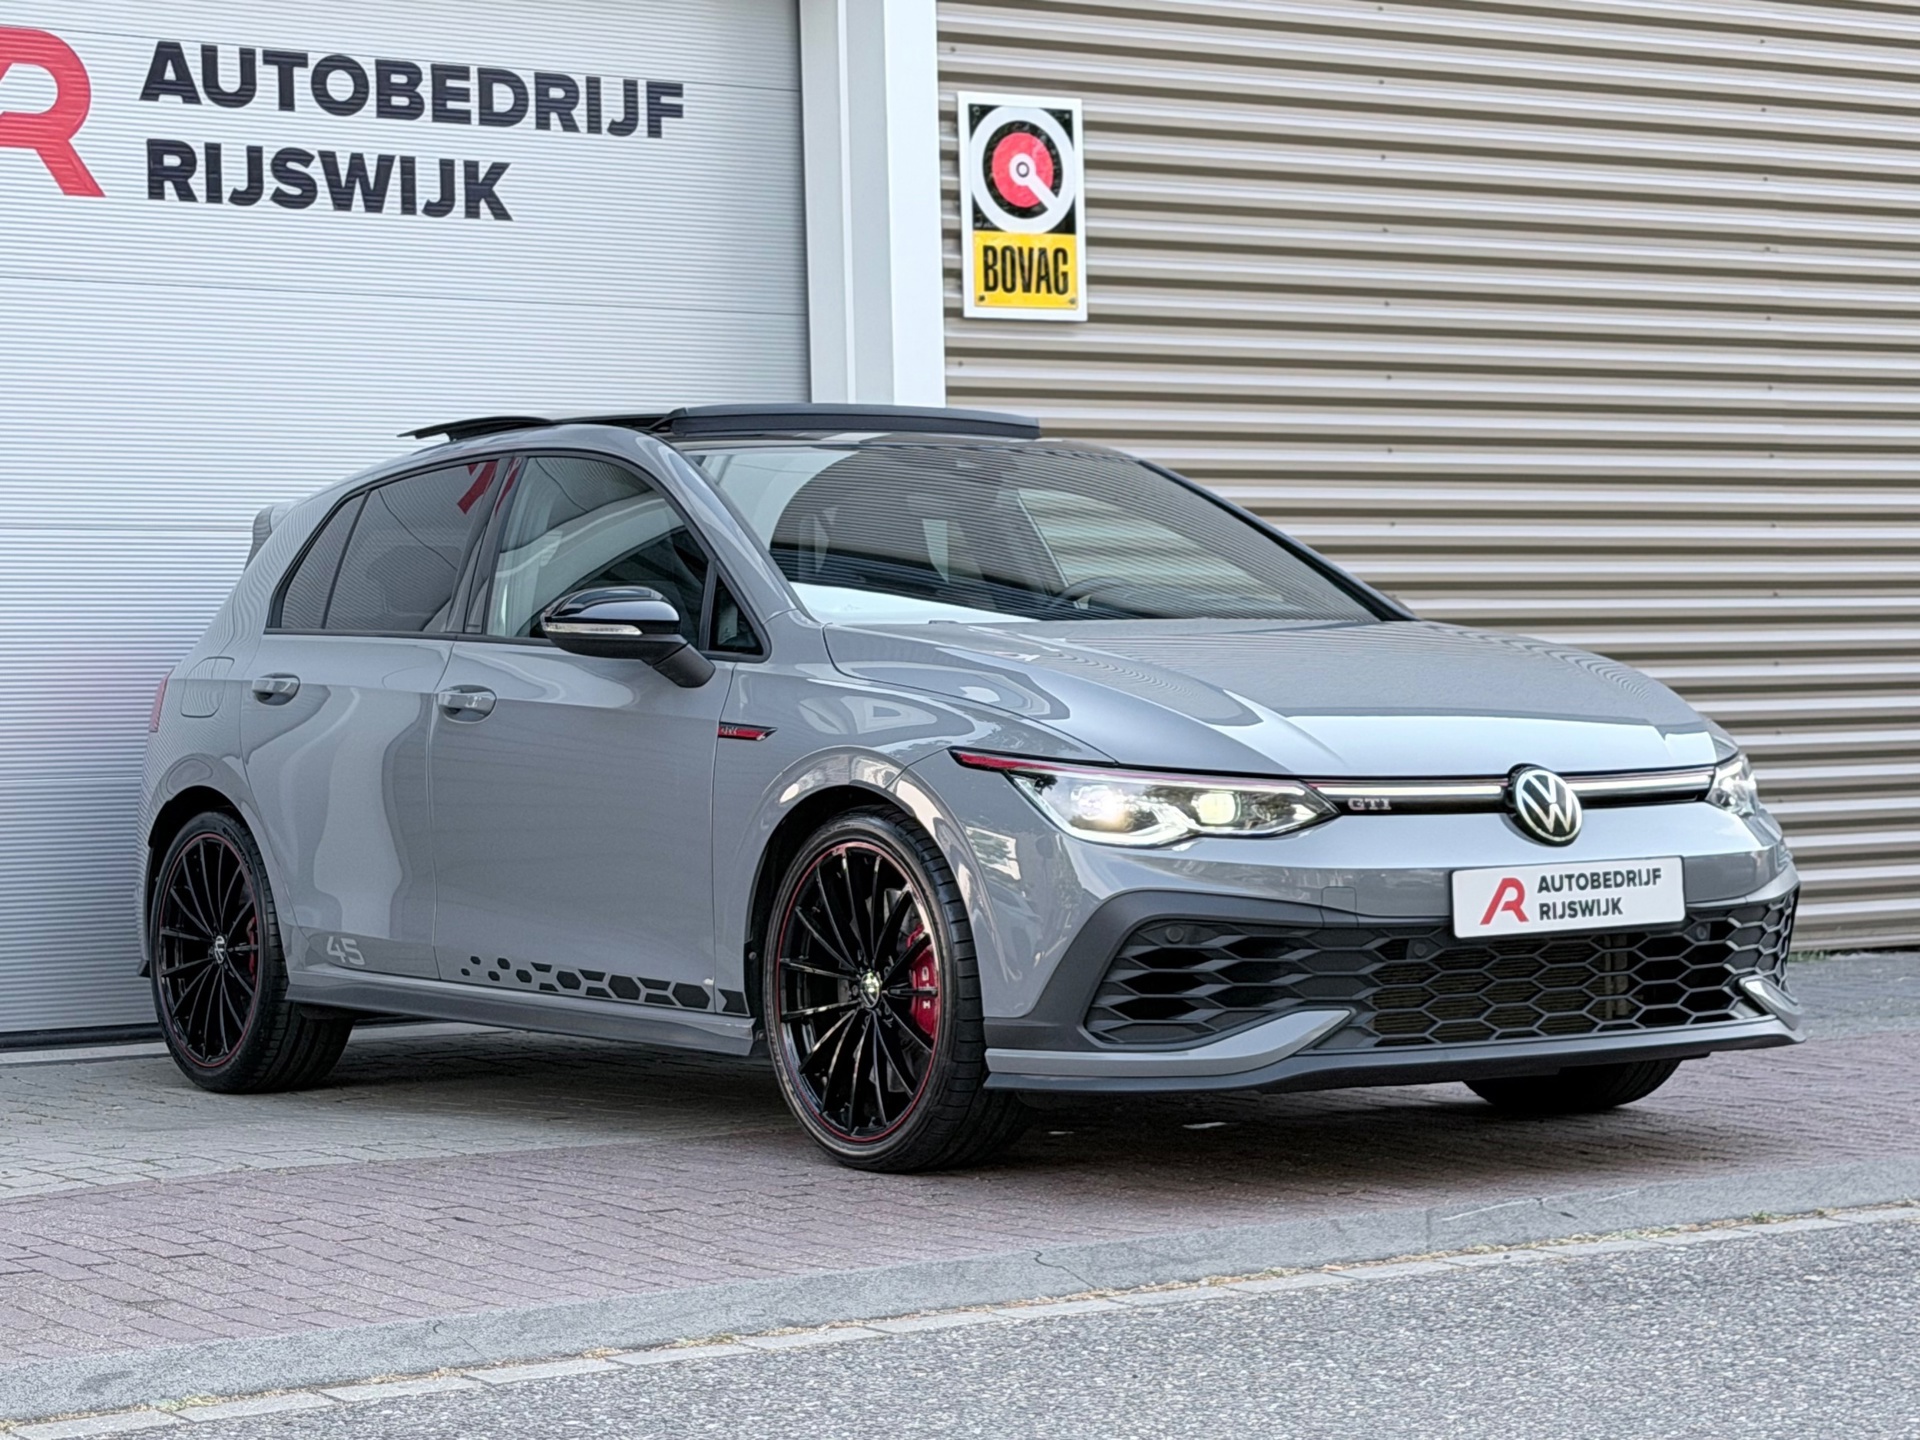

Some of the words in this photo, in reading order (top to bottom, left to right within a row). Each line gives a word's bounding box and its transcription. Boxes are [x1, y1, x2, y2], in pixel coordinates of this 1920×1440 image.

[139, 40, 684, 138] AUTOBEDRIJF
[145, 137, 514, 222] RIJSWIJK
[982, 244, 1069, 296] BOVAG
[1348, 798, 1392, 811] GTI
[1537, 867, 1662, 894] AUTOBEDRIJF
[1538, 896, 1623, 921] RIJSWIJK
[326, 935, 365, 966] 45
